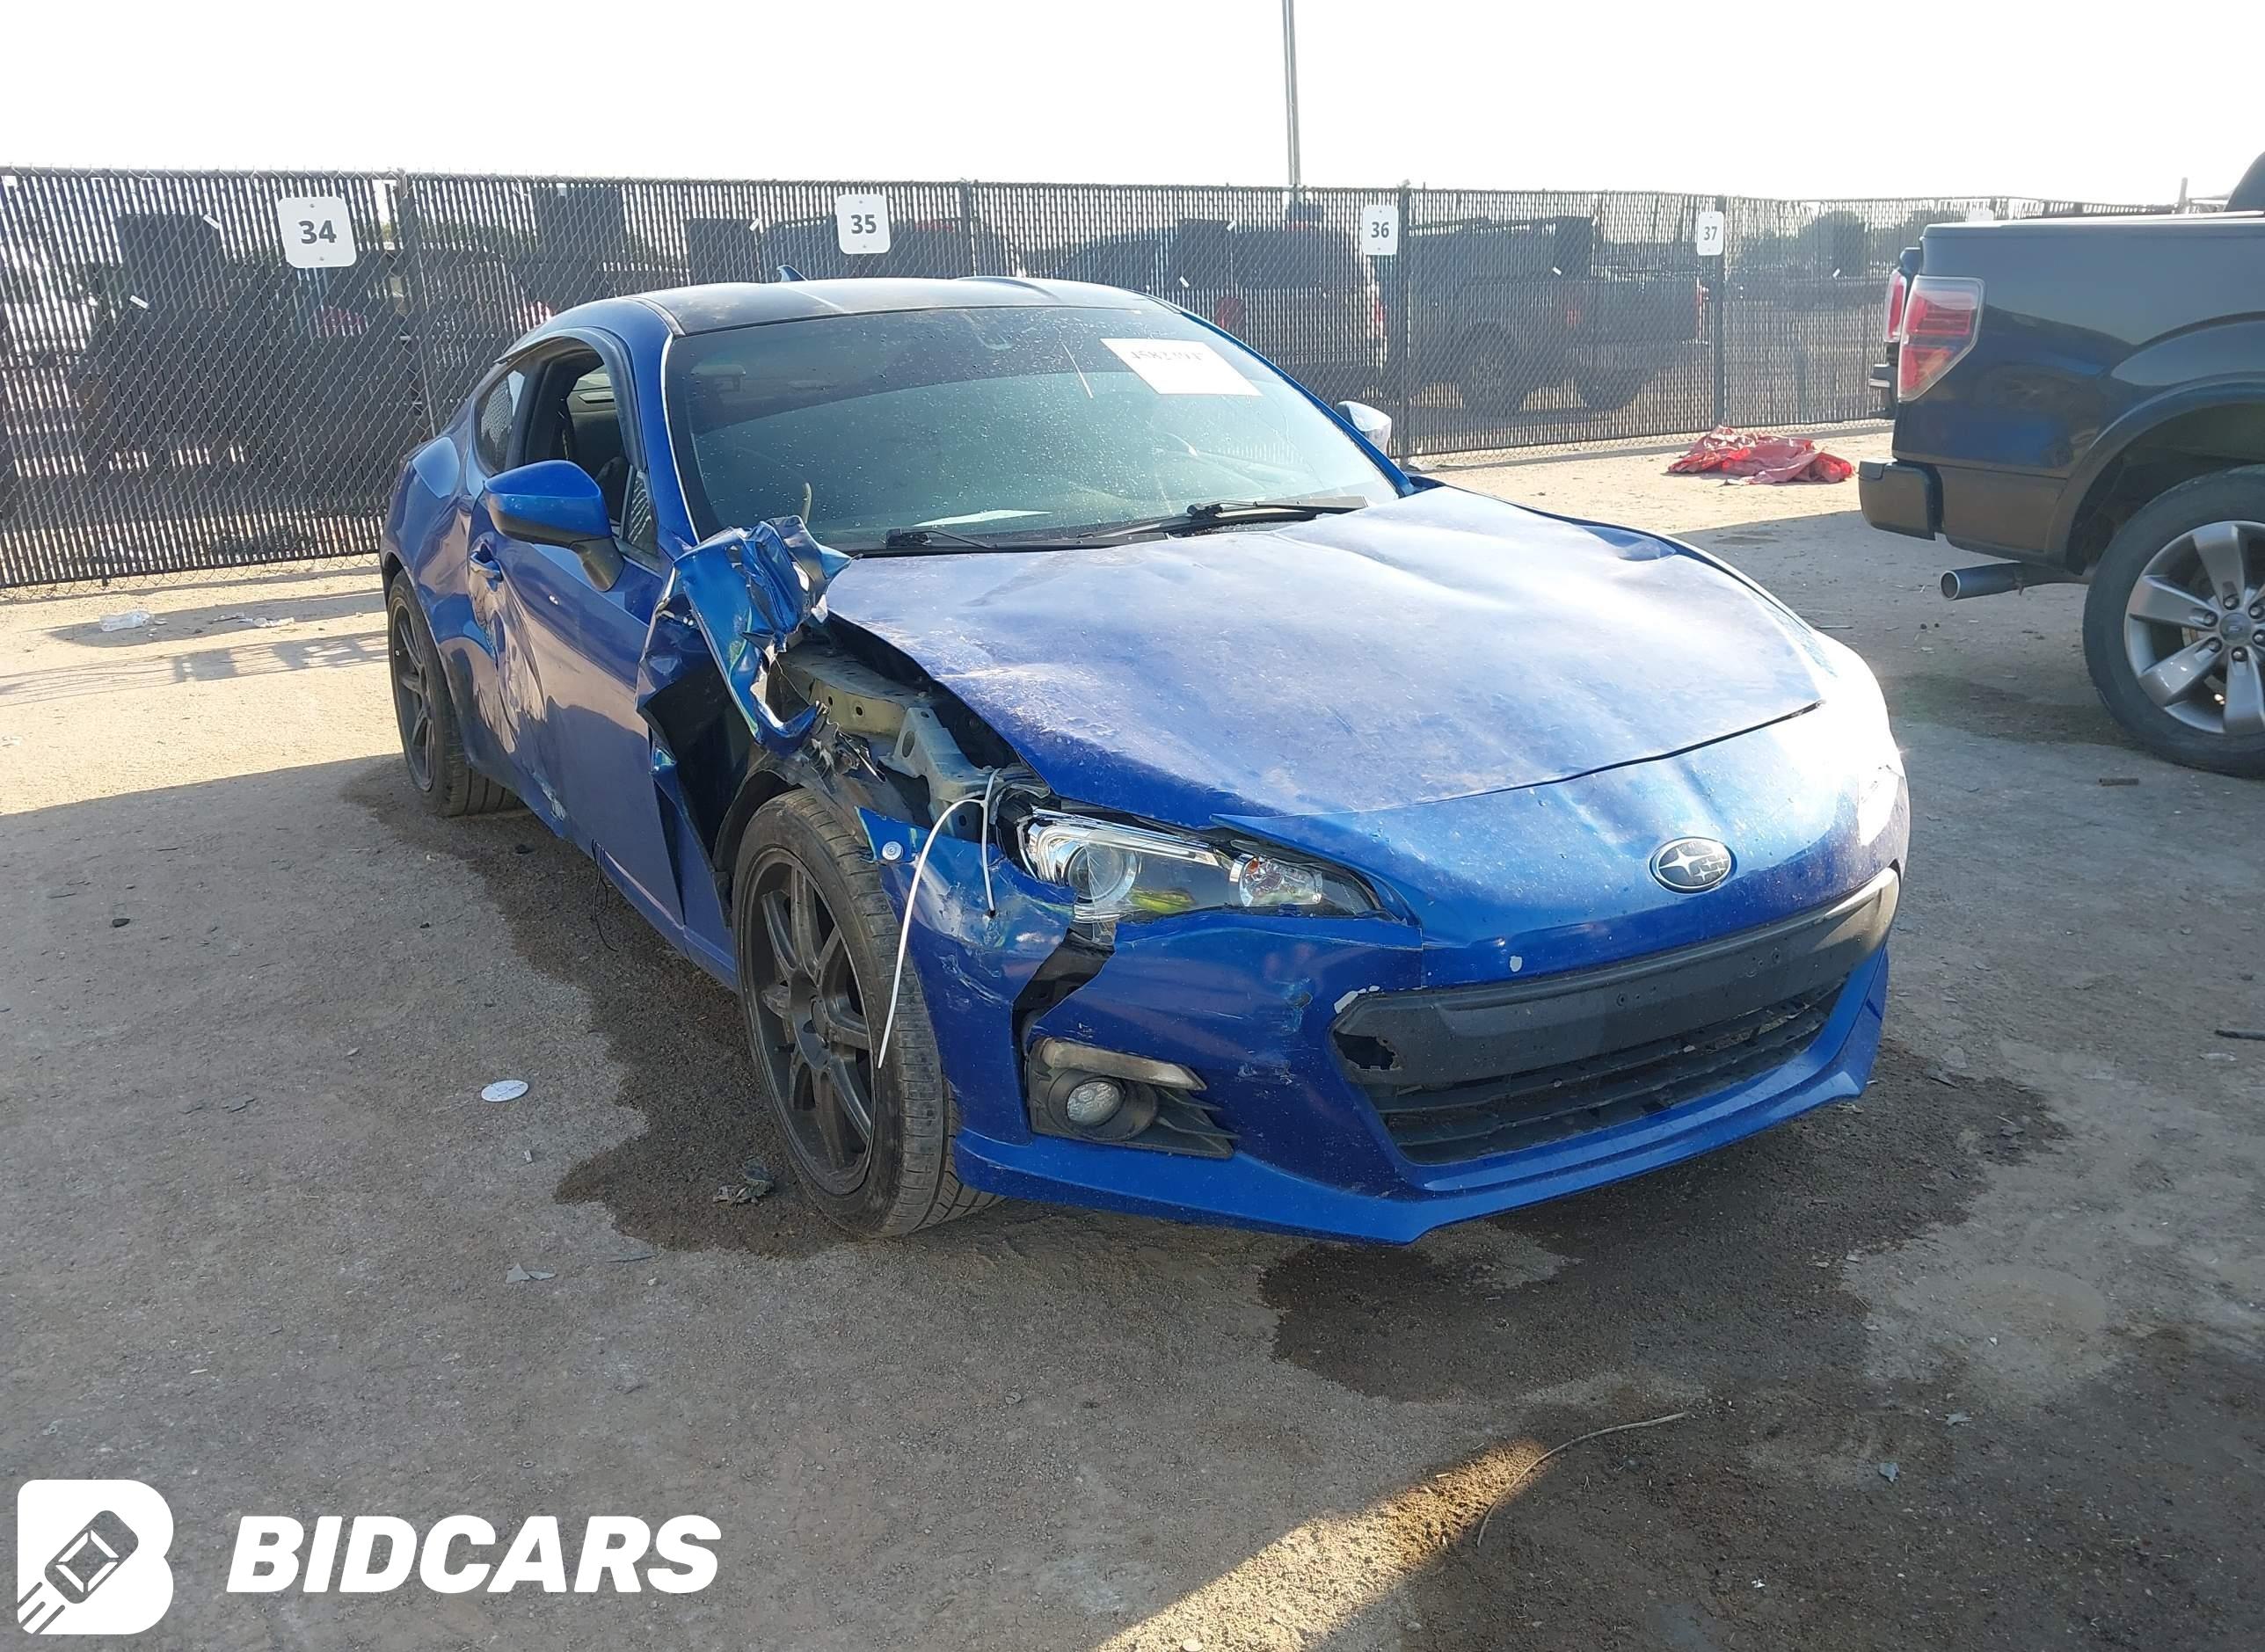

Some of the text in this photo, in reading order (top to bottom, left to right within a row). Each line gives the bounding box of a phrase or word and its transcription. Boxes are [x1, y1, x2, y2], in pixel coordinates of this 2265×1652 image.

[299, 220, 336, 244] 34
[850, 214, 877, 235] 35
[1371, 222, 1389, 238] 36
[1704, 226, 1717, 241] 37
